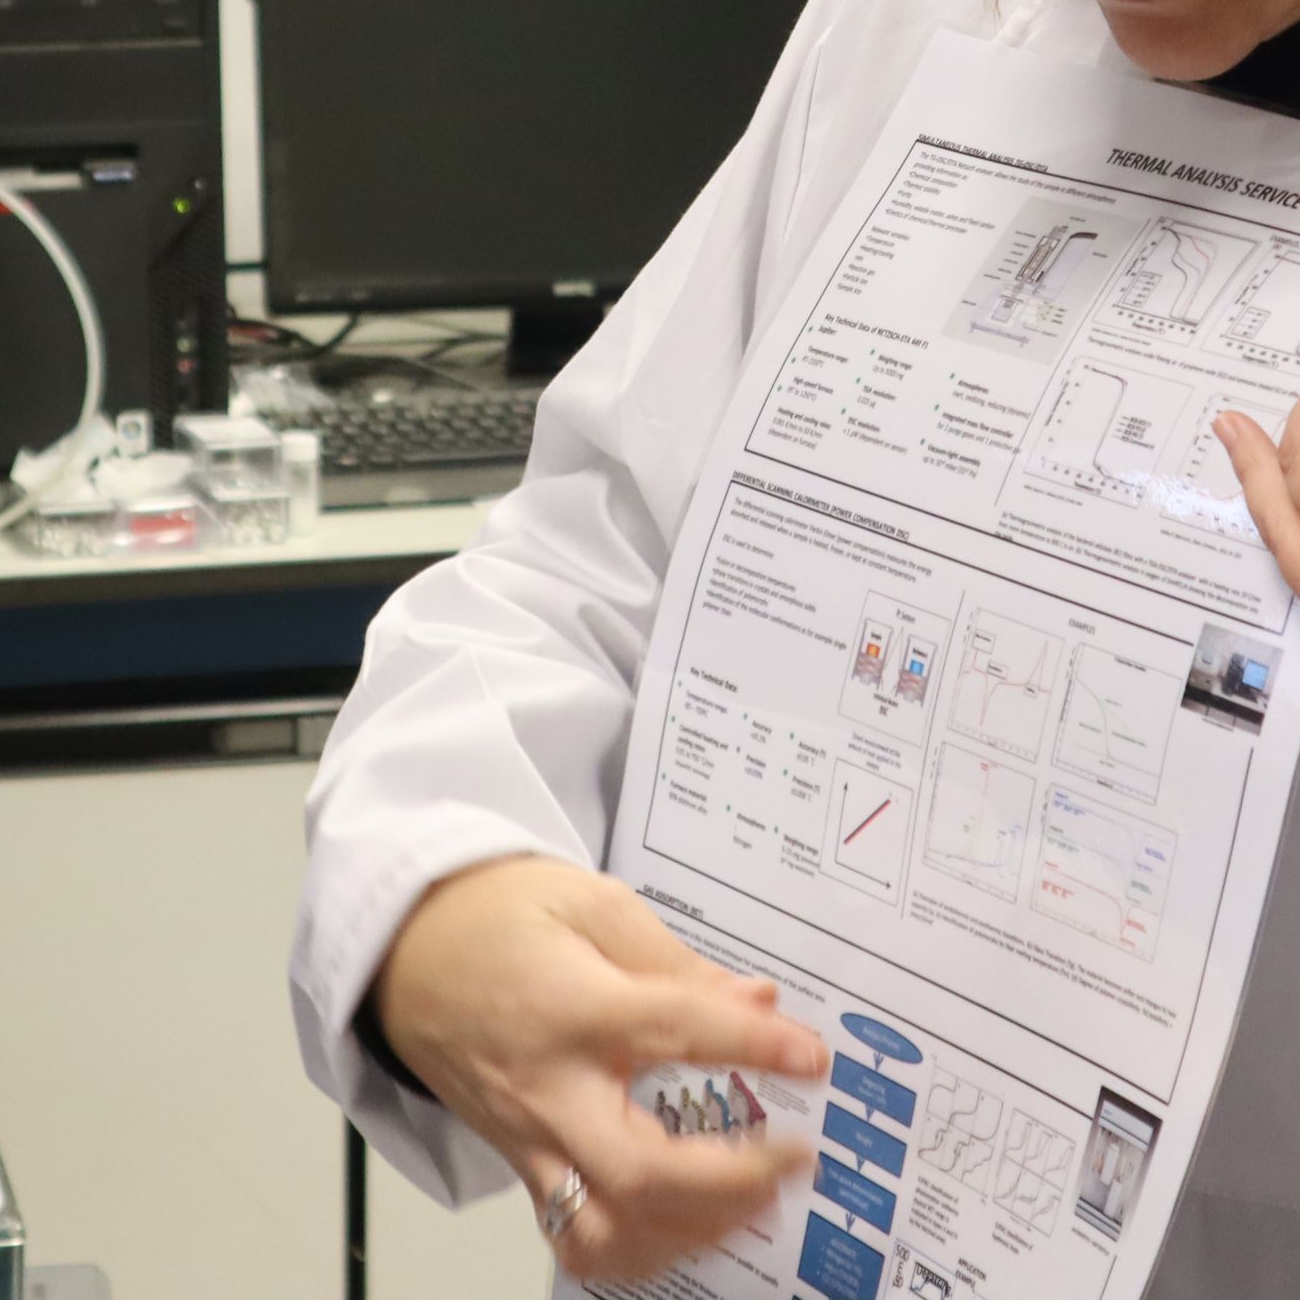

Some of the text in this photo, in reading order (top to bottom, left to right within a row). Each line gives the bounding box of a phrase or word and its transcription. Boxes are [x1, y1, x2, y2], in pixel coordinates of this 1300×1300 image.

[1106, 148, 1174, 177] THERMAL
[1170, 163, 1243, 193] ANALYSIS
[823, 313, 836, 323] Key
[833, 316, 859, 329] Technical
[856, 323, 872, 333] Data
[869, 326, 878, 335] of
[732, 470, 910, 541] DIFFERENTIAL SCANNING CALORIMETER (POWER COMPENSATION DSC)
[1068, 618, 1097, 636] EXAMPLES
[690, 665, 701, 677] Key
[700, 670, 724, 688] Technical
[958, 1258, 987, 1282] APPLICATION
